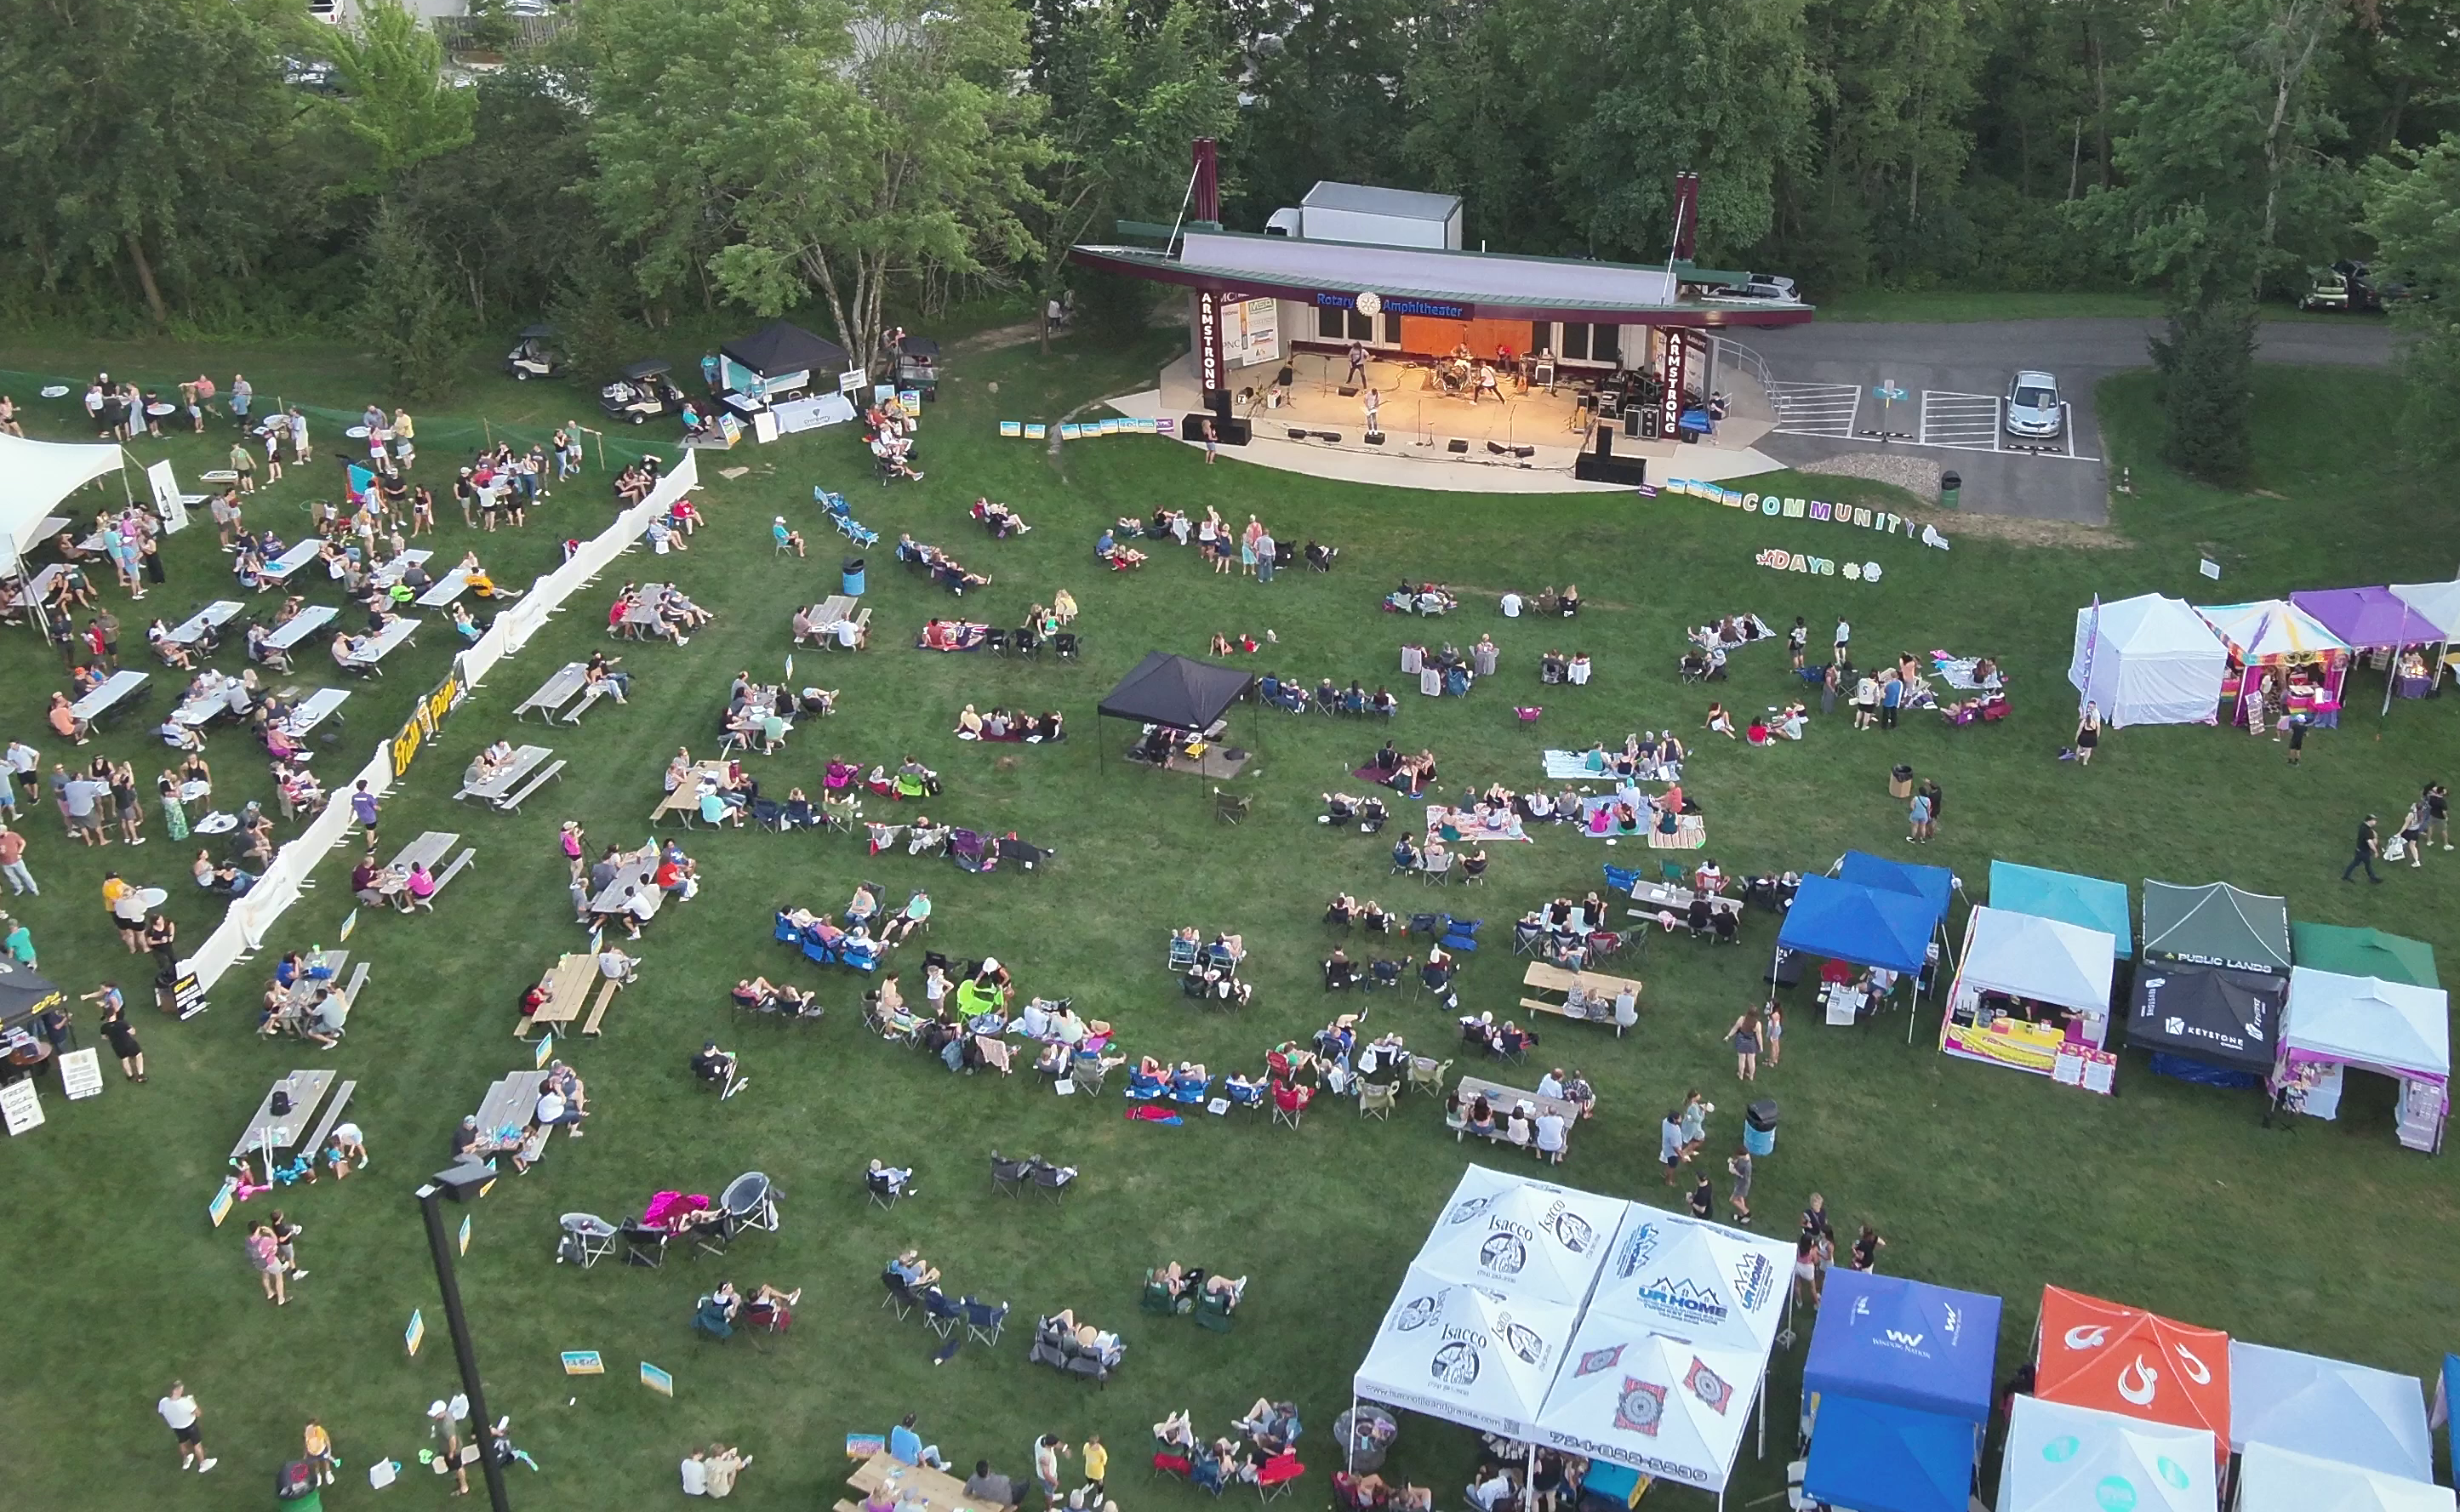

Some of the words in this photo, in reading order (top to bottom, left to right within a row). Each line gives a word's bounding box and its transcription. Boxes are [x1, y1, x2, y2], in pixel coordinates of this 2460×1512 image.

[1250, 300, 1272, 311] MSA
[1317, 293, 1356, 310] Rotary
[1383, 300, 1463, 317] Amphitheater
[1201, 293, 1215, 390] ARMSTRONG
[1664, 333, 1681, 433] ARMSTRONG
[1743, 493, 1915, 539] COMMUNITY
[1771, 549, 1835, 576] DAYS
[2177, 952, 2223, 966] PUBLIC
[2226, 959, 2273, 974] LANDS
[2188, 1026, 2244, 1047] KEYSTONE
[1487, 1214, 1533, 1242] Isacco
[1538, 1200, 1566, 1235] Isacco
[1749, 1252, 1767, 1292] HOME
[1638, 1287, 1668, 1304] UR
[1669, 1293, 1728, 1319] HOME
[1441, 1323, 1487, 1349] Isacco
